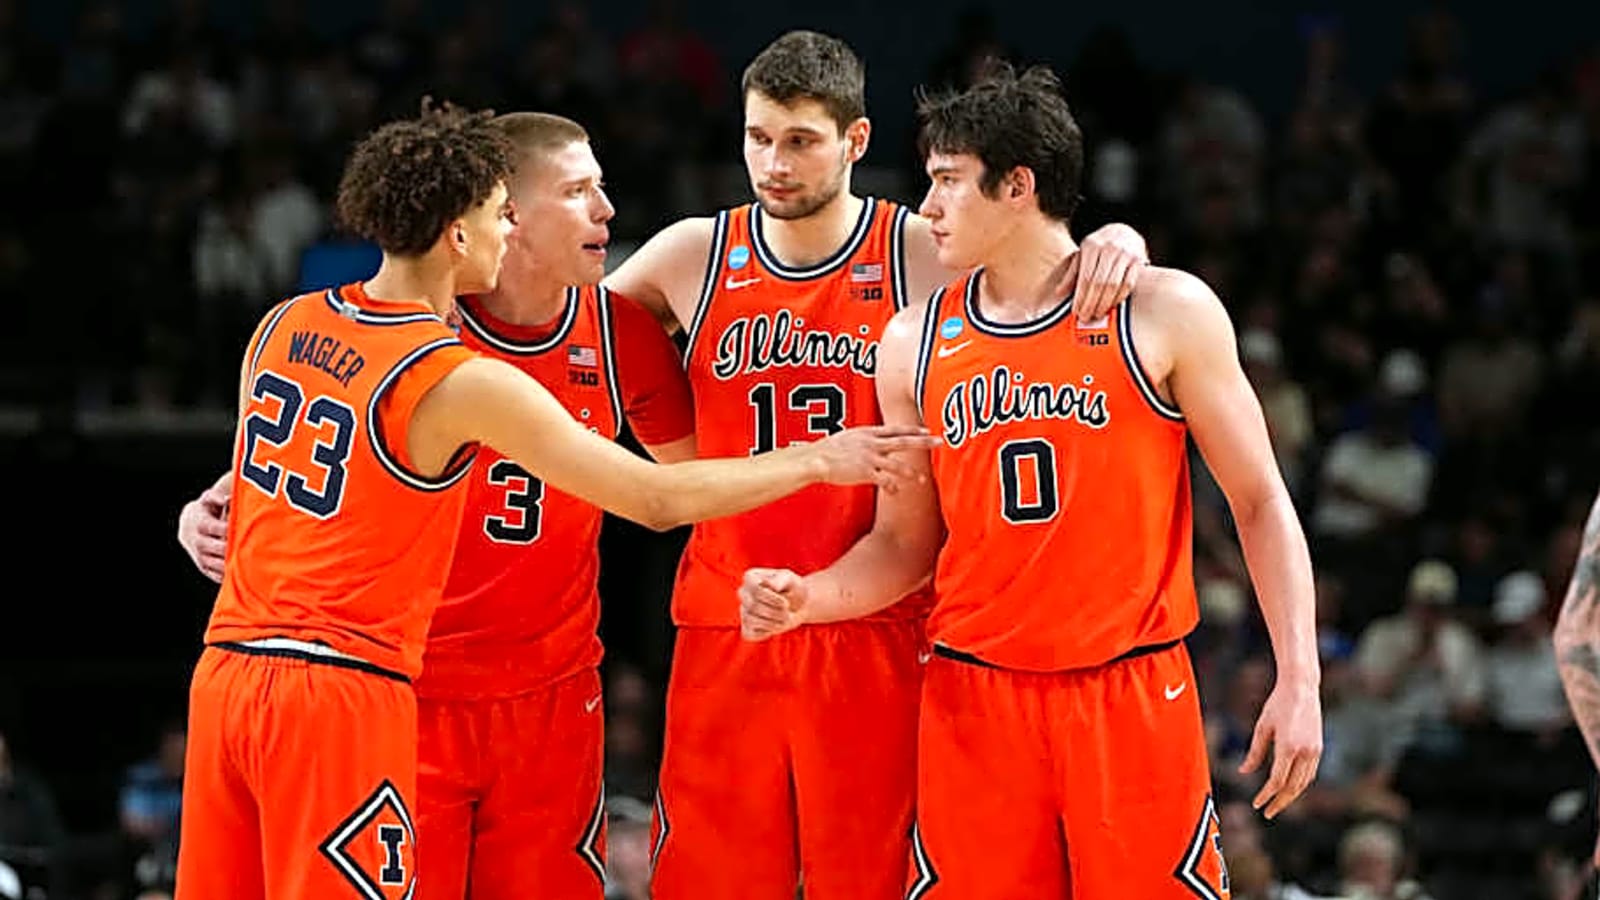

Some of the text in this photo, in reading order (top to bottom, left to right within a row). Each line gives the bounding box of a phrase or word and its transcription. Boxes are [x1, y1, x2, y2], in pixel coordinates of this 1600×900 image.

[287, 330, 365, 388] WAGLER
[714, 309, 880, 381] Illinois
[241, 371, 356, 519] 23
[942, 365, 1111, 449] Illinois
[998, 437, 1059, 524] 0
